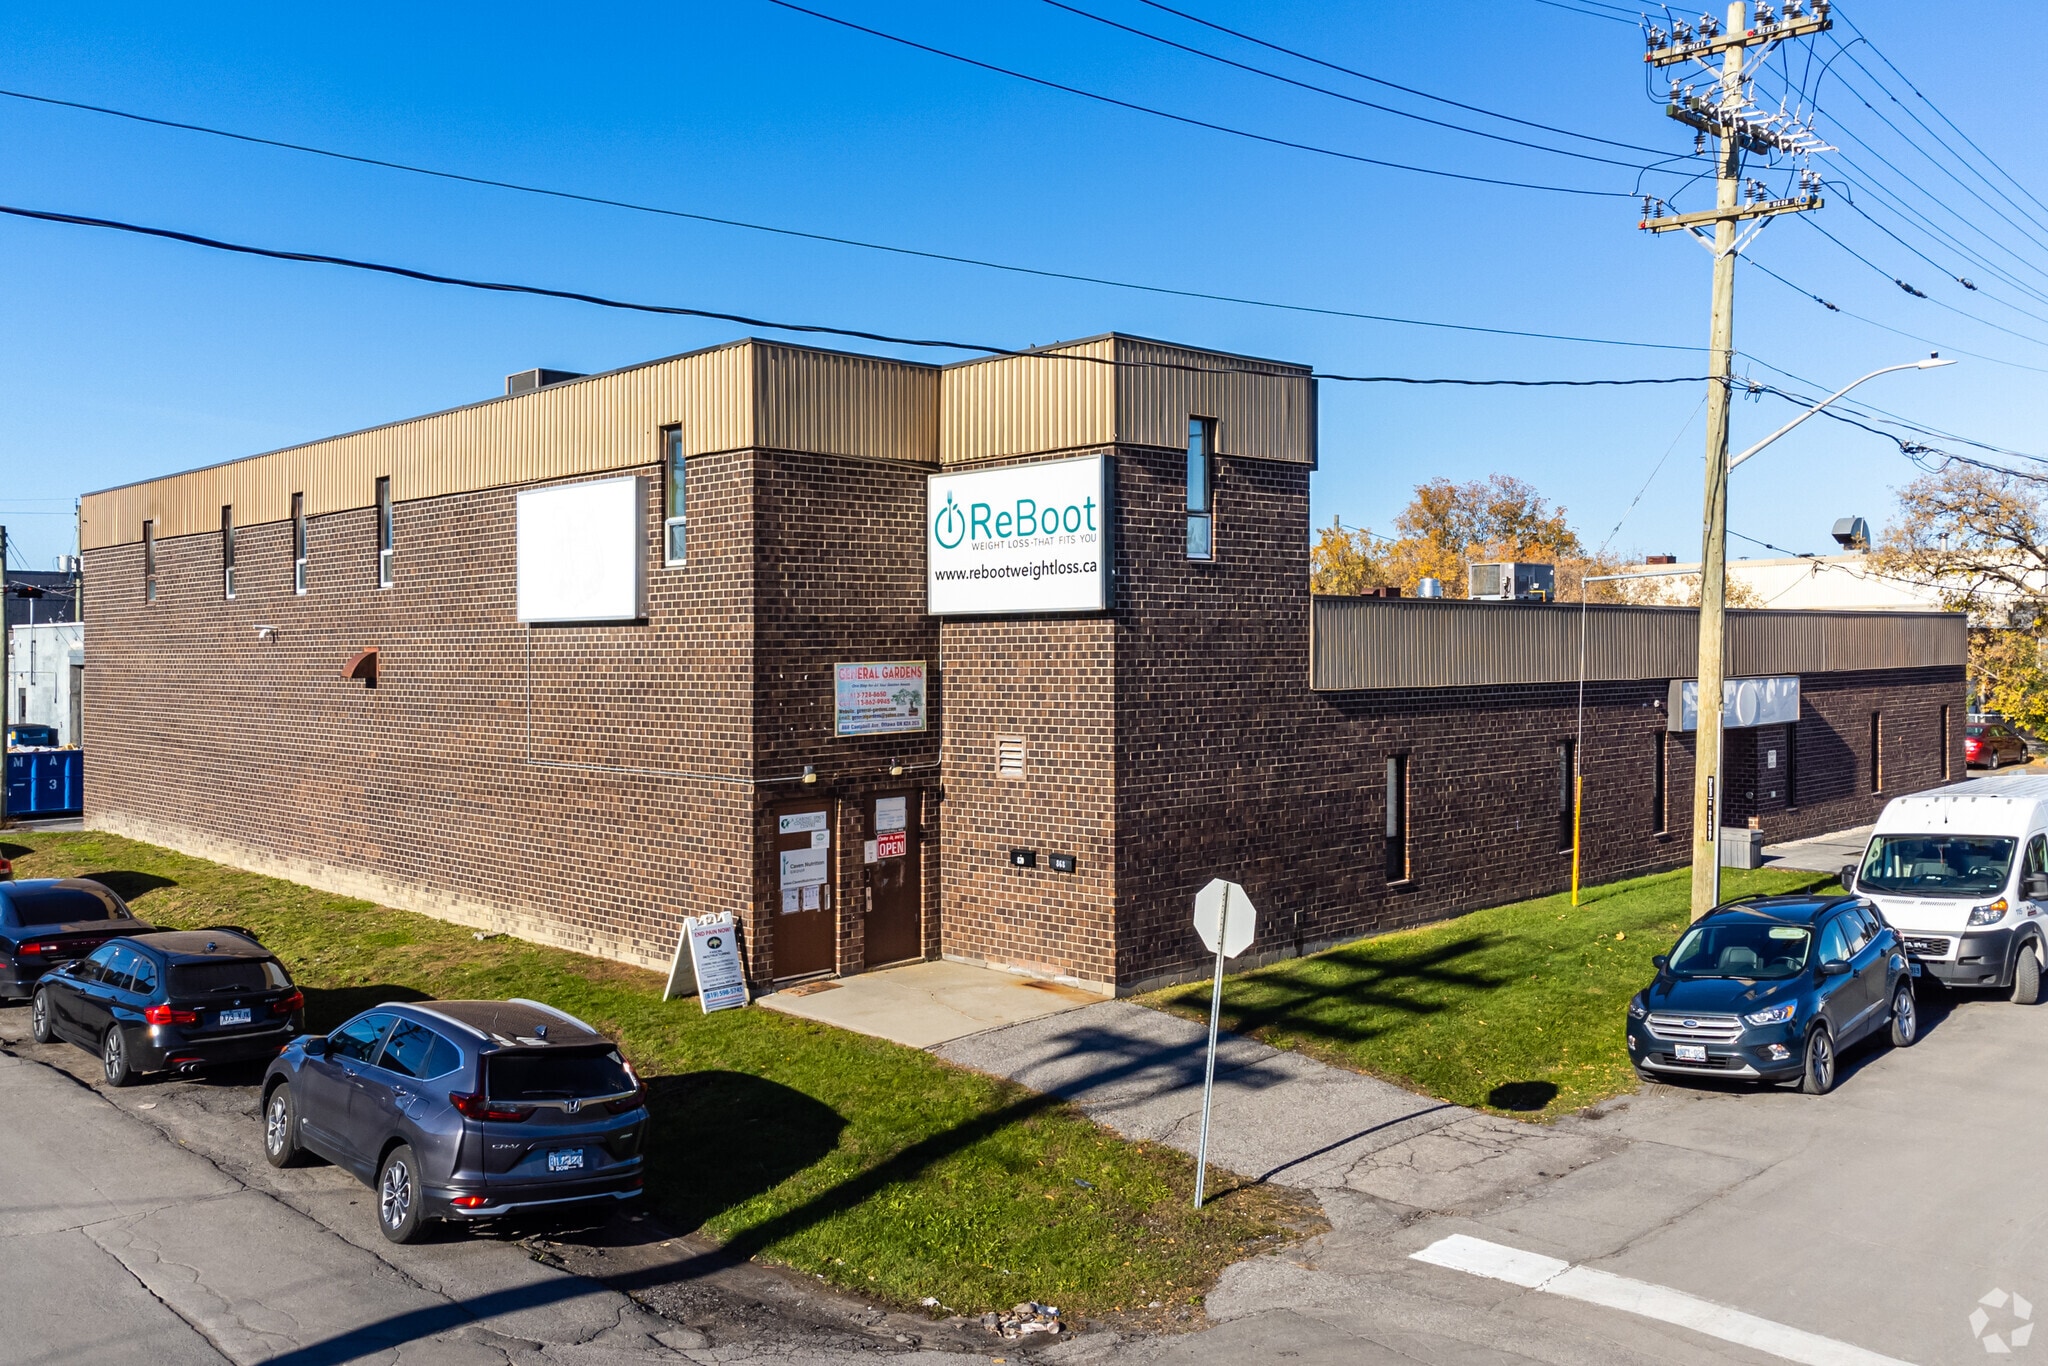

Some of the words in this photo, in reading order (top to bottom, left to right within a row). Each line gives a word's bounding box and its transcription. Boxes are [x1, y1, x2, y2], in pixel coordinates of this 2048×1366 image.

[970, 496, 1097, 540] ReBoot
[972, 540, 1005, 551] WEIGHT
[1059, 535, 1076, 545] FITS
[1080, 533, 1097, 543] YOU
[935, 559, 1097, 581] www.rebootweightloss.ca
[839, 666, 879, 680] GENERAL
[881, 665, 923, 679] GARDENS
[879, 840, 904, 857] OPEN
